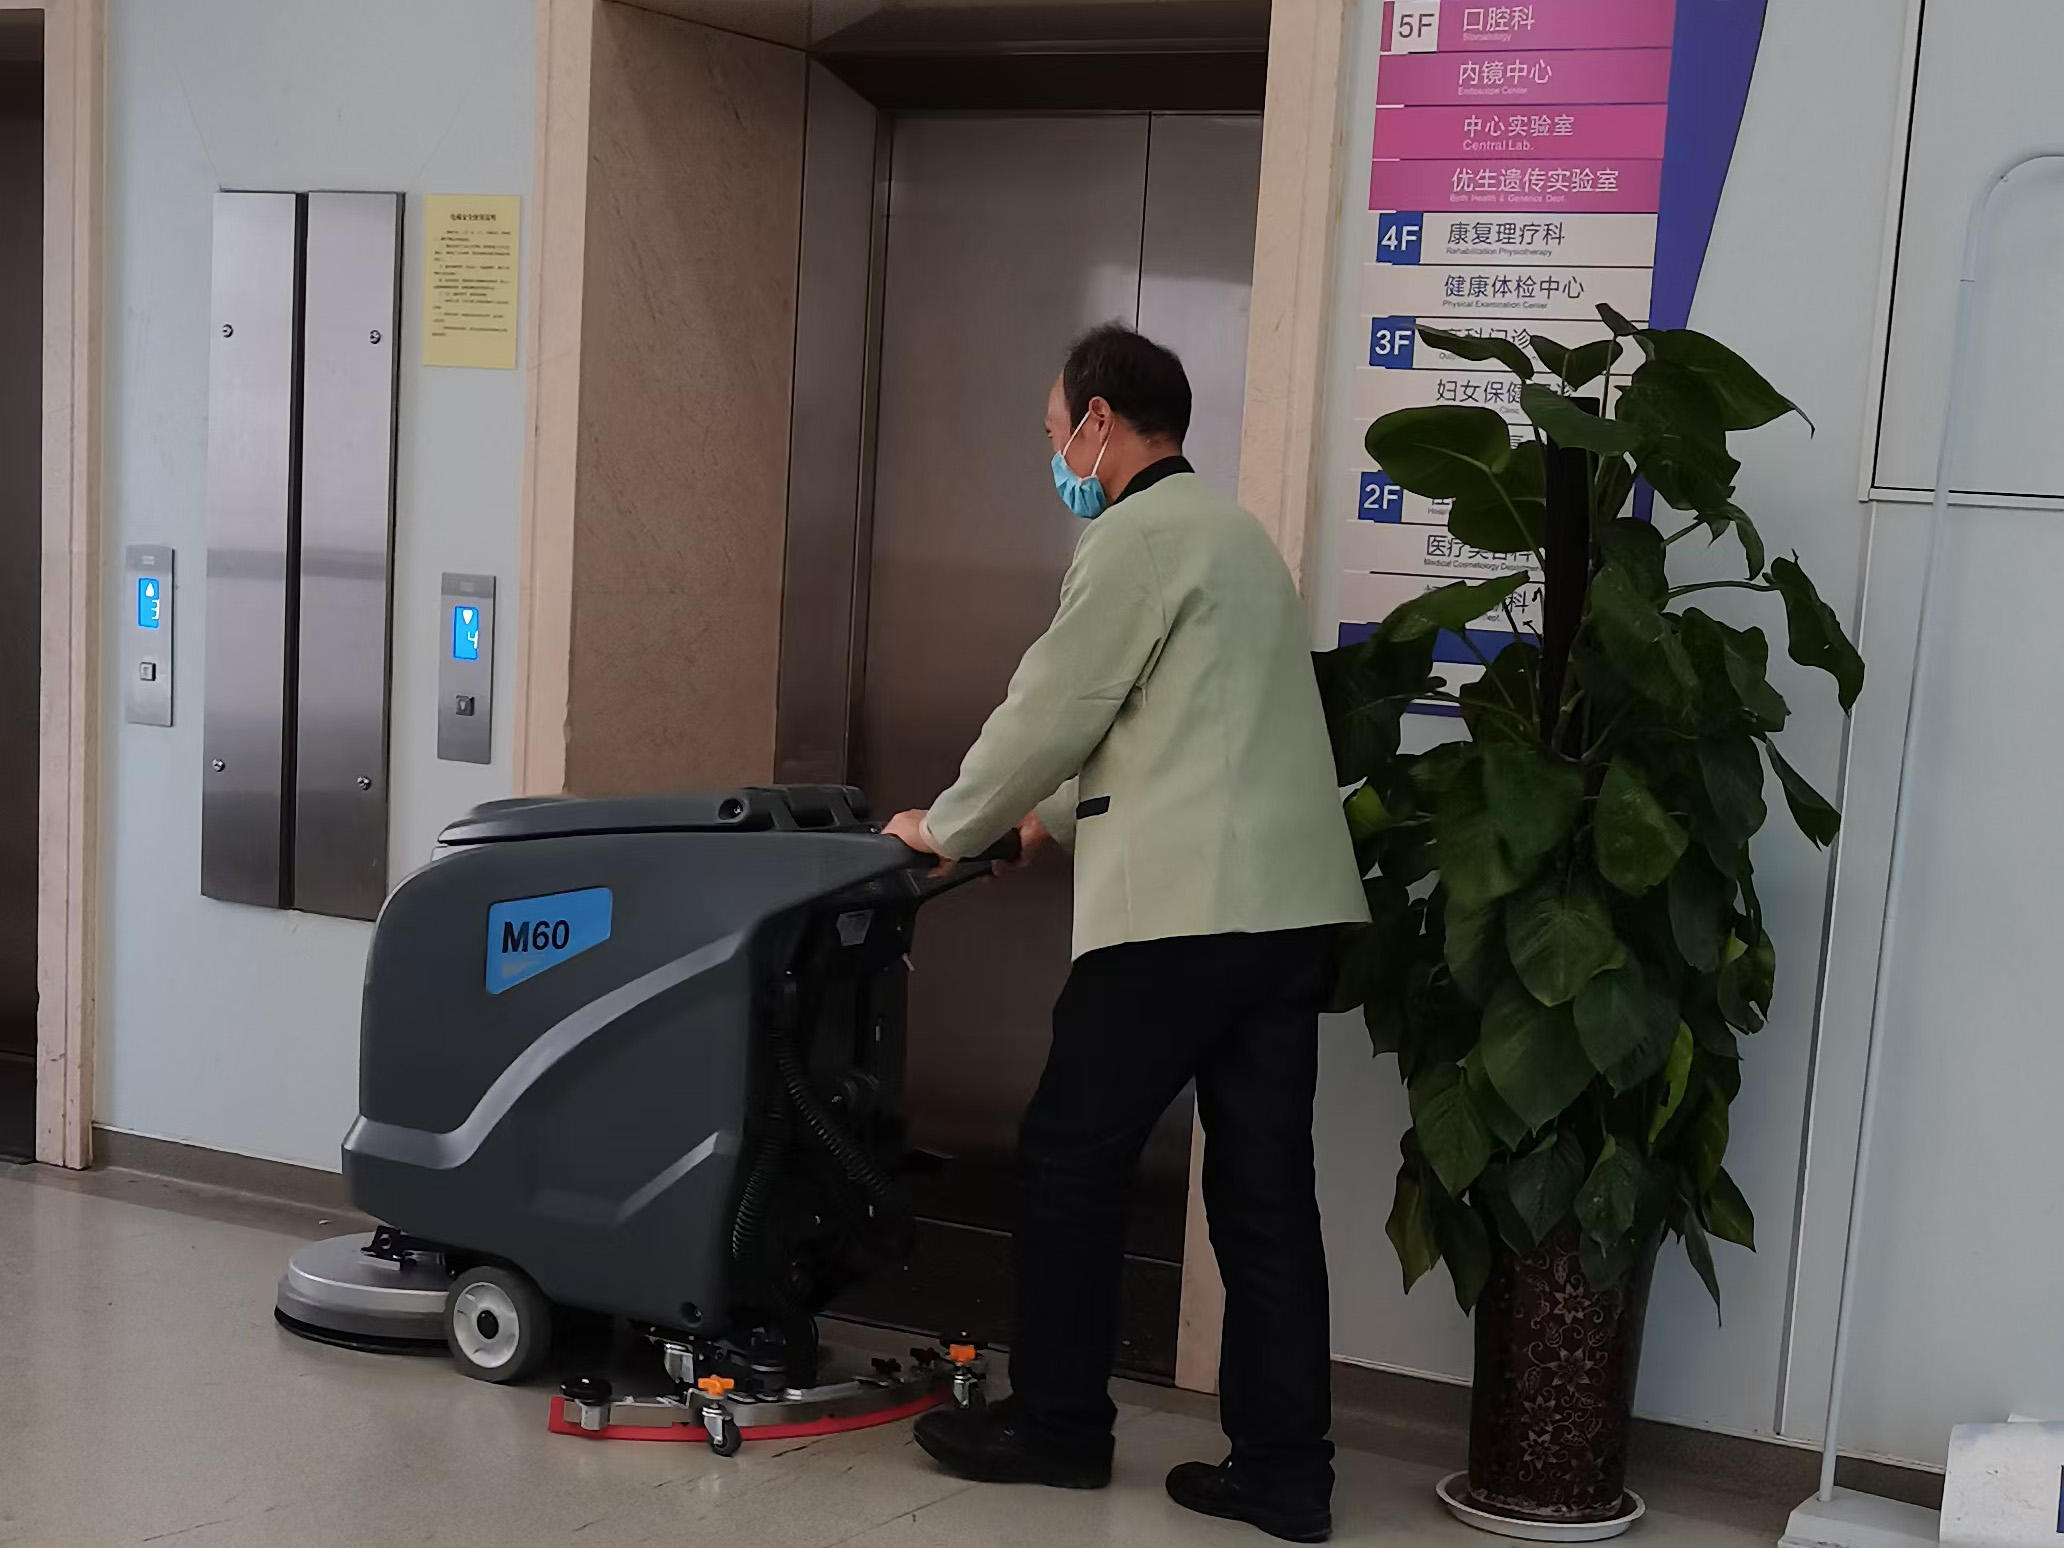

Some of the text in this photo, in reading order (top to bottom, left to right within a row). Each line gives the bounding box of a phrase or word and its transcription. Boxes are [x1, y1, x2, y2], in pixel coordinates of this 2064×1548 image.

[1398, 13, 1435, 39] 5F
[1463, 4, 1535, 31] 口腔科
[1459, 59, 1552, 84] 内镜中心
[1464, 114, 1574, 138] 中心实验室
[1463, 139, 1534, 150] Central Lab.
[1452, 167, 1619, 192] 优生遗传实验室
[1380, 225, 1420, 251] 4F
[1447, 222, 1565, 246] 康复理疗科
[1444, 274, 1585, 300] 健康体检中心
[1442, 299, 1473, 308] Physical
[1375, 330, 1413, 356] 3F
[1363, 484, 1400, 510] 2F
[1424, 558, 1452, 567] Medical
[151, 599, 160, 620] 3
[467, 630, 479, 650] 4
[502, 919, 570, 954] M60
